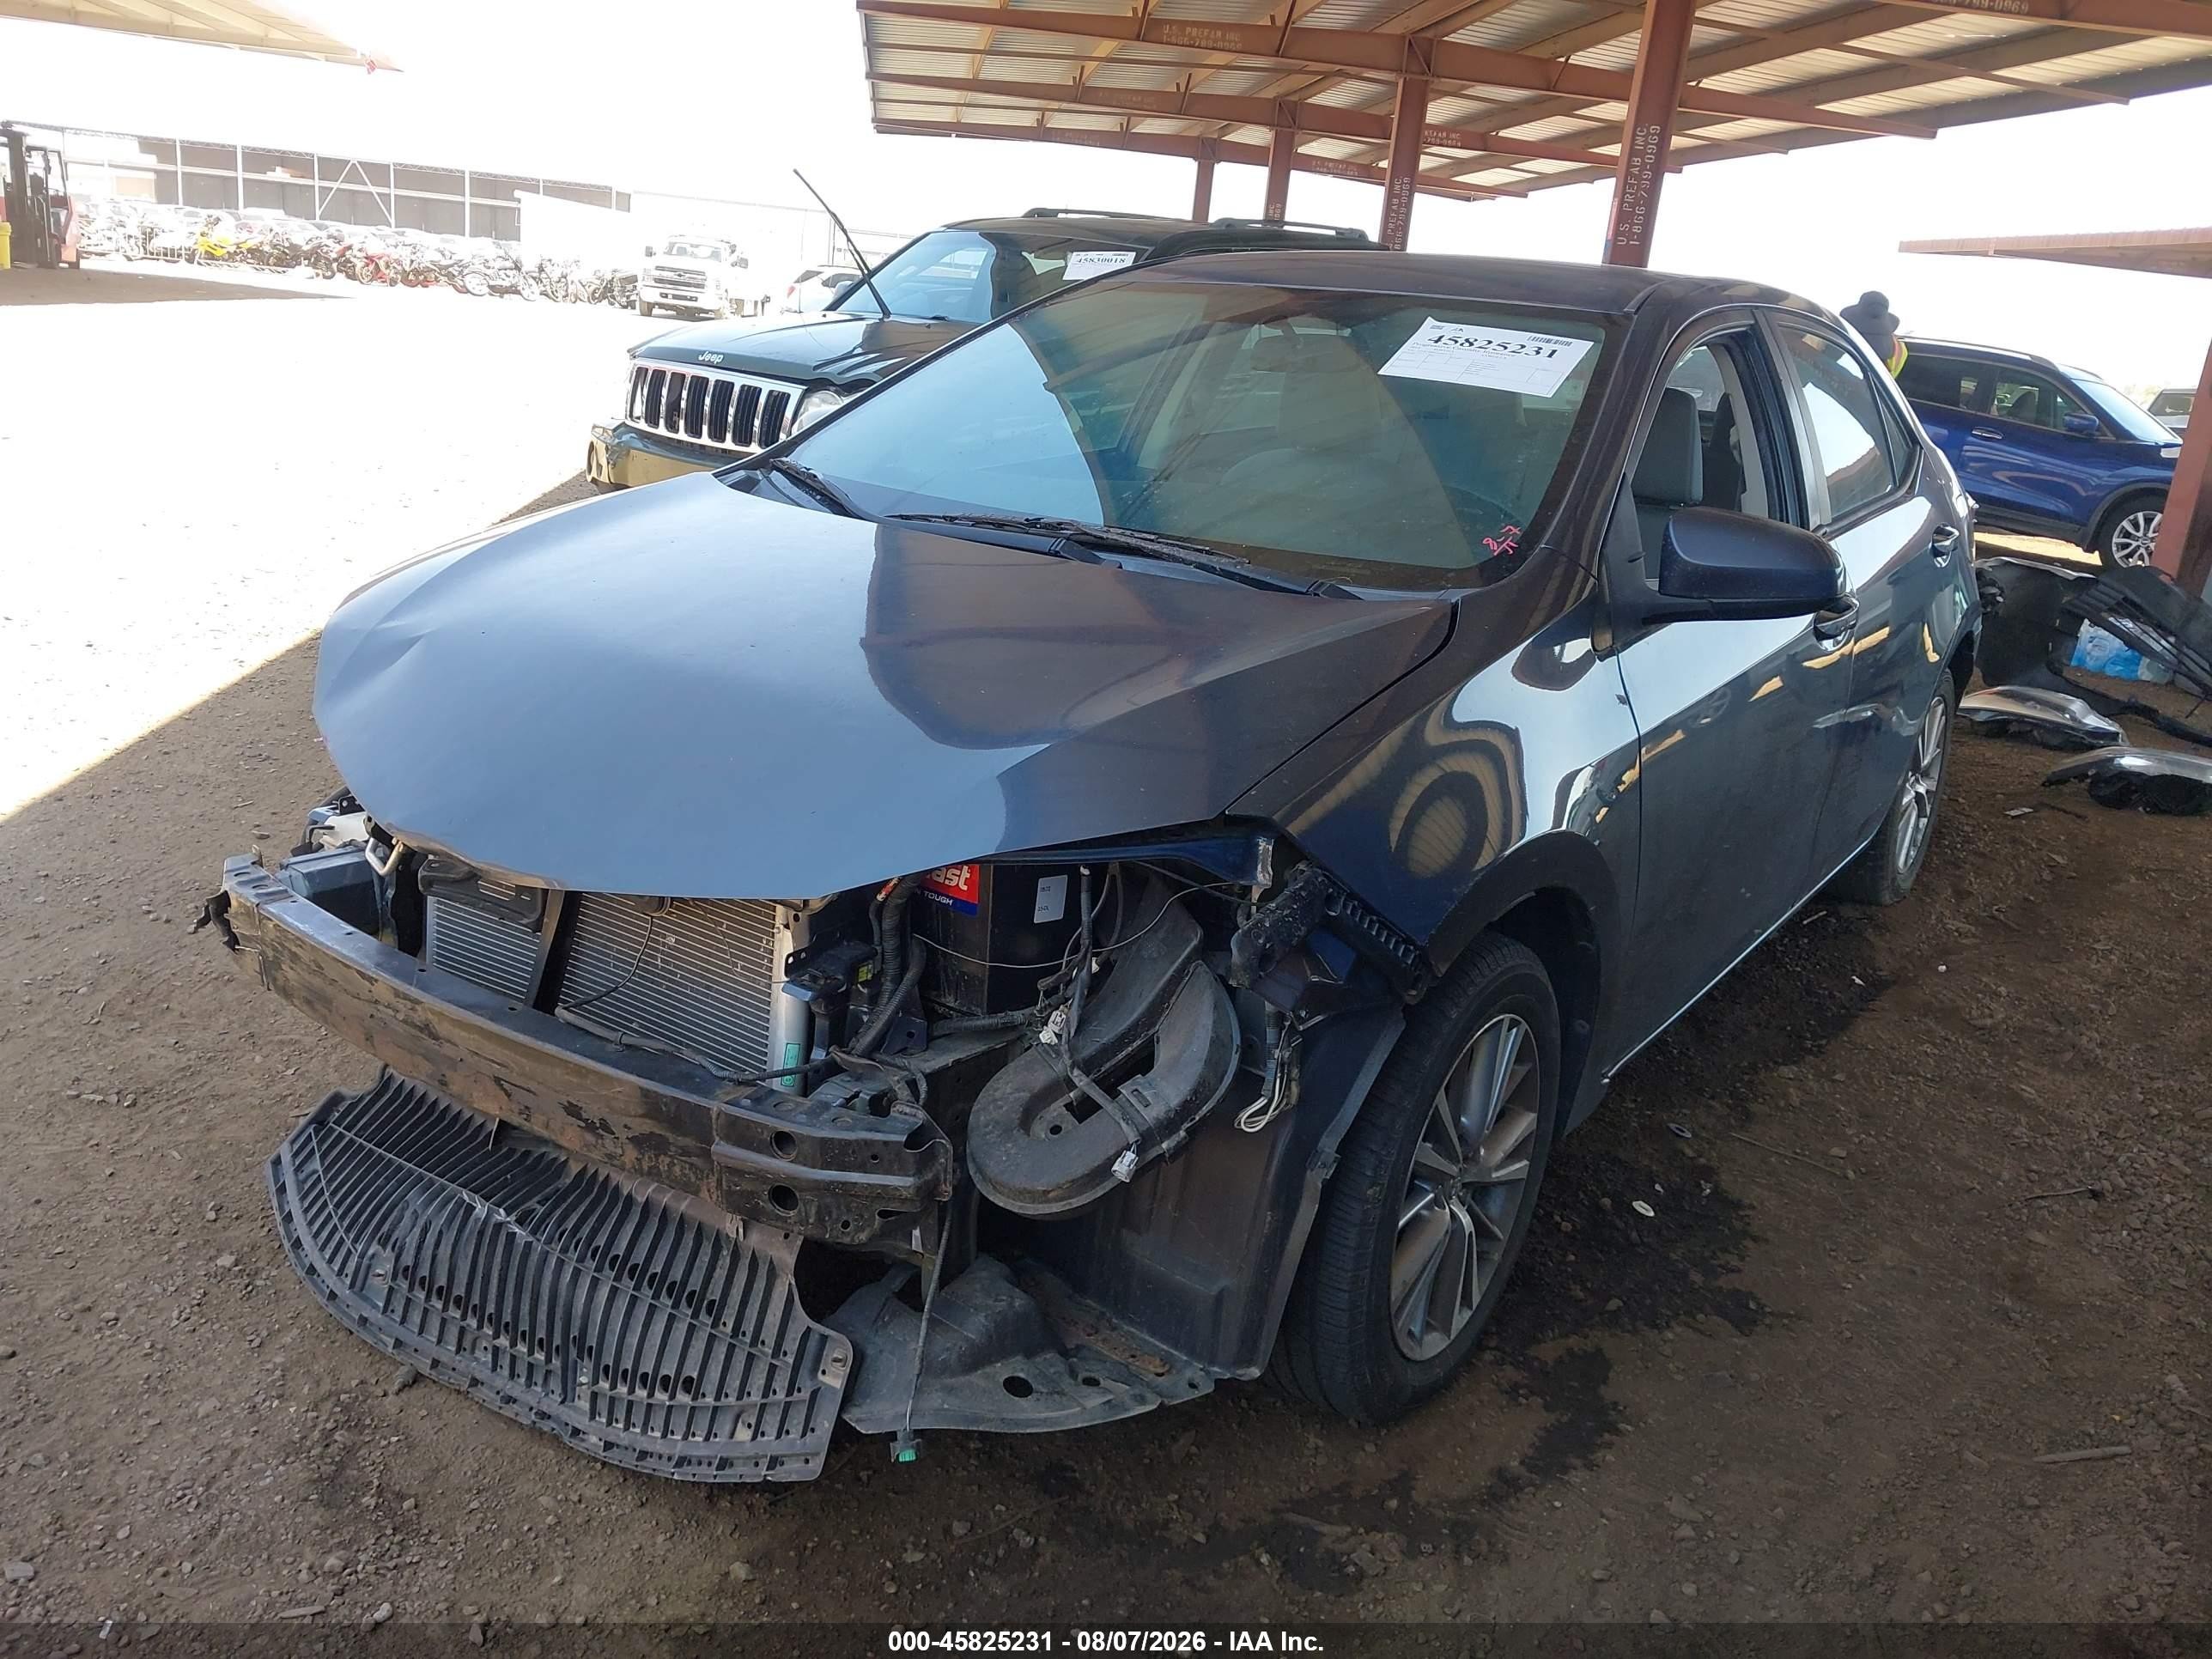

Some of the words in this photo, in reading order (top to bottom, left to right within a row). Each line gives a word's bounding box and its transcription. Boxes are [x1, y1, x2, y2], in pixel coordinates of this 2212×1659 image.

[1634, 123, 1648, 149] INC.
[1623, 157, 1642, 211] PREFAB
[1629, 125, 1662, 245] 1-866-799-0969
[1388, 198, 1400, 234] PREFAB
[1395, 177, 1411, 250] 866-799-0969
[1617, 219, 1632, 245] U.S.
[698, 351, 724, 364] Jeep
[1427, 334, 1559, 358] 45825231
[927, 865, 971, 891] ast
[924, 890, 954, 906] TOUGH
